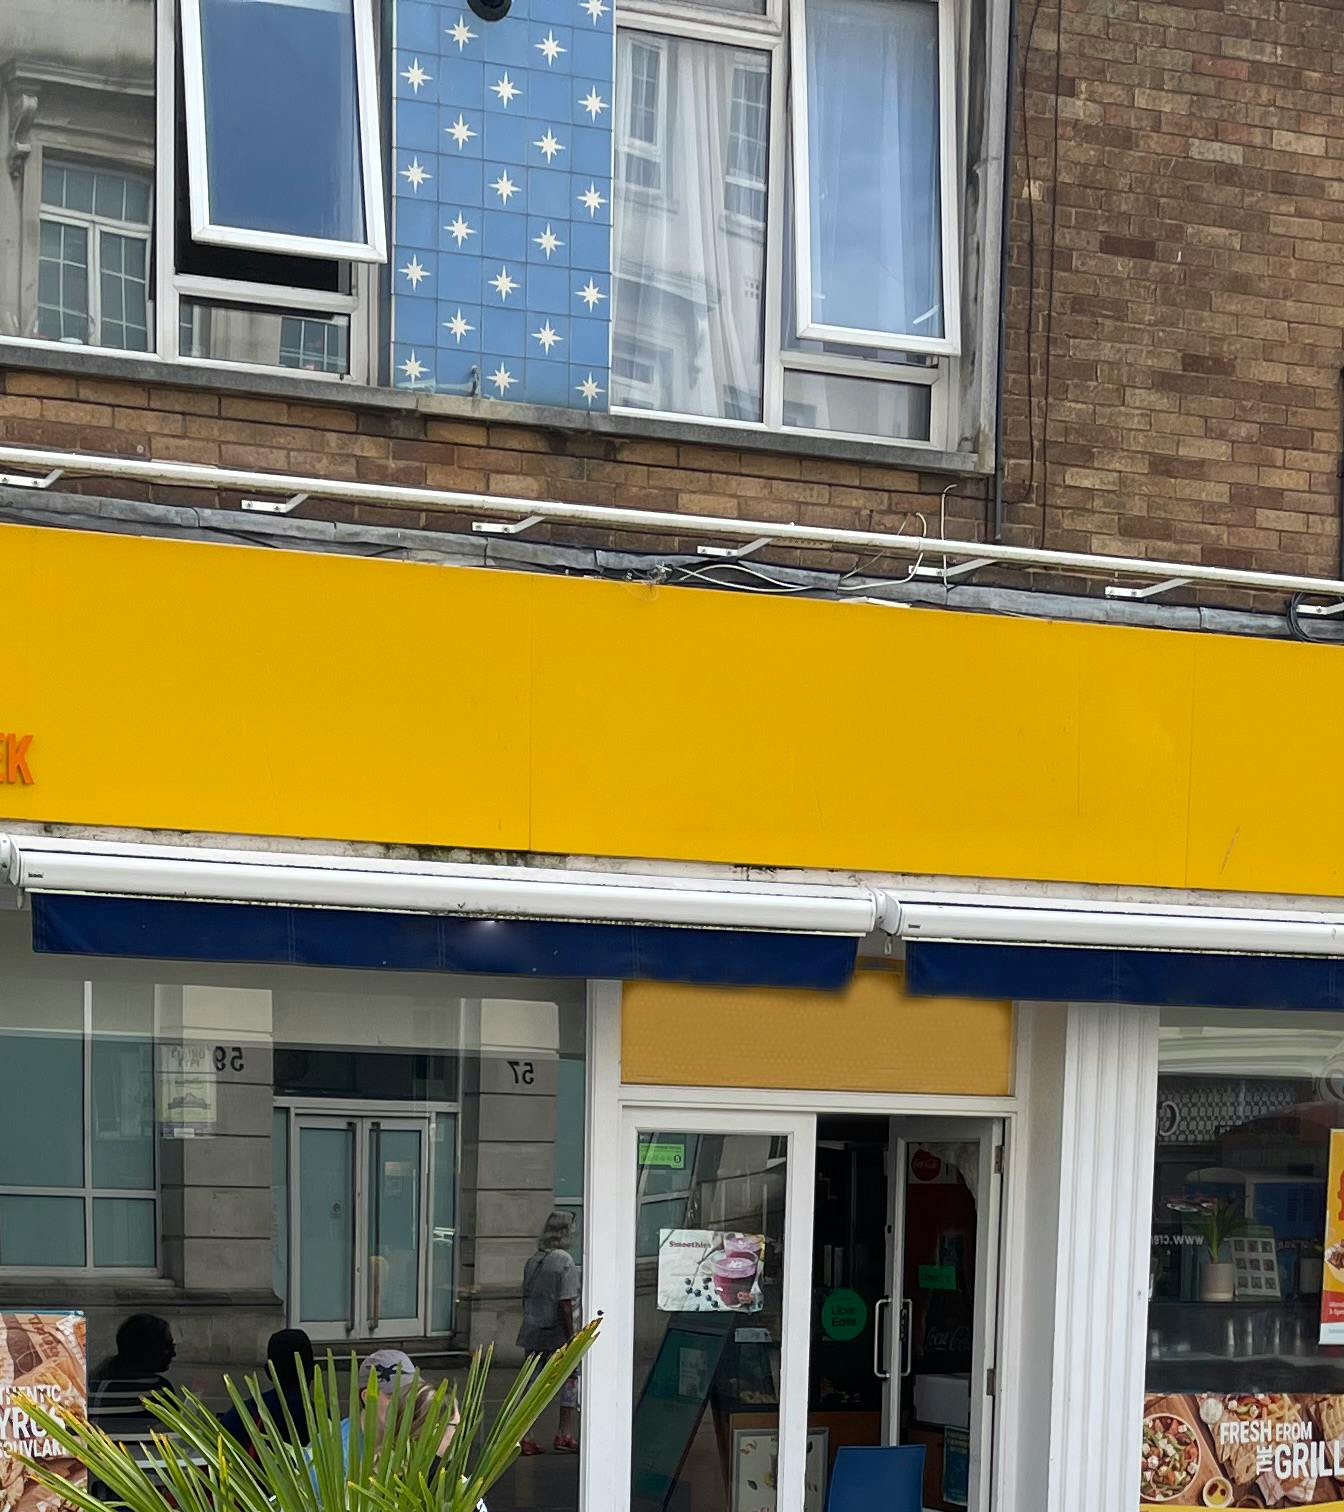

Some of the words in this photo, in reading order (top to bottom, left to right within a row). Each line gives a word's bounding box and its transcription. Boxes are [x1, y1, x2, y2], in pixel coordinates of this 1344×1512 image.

[1219, 1419, 1274, 1446] FRESH
[1275, 1420, 1314, 1442] FROM
[1256, 1444, 1274, 1475] THE
